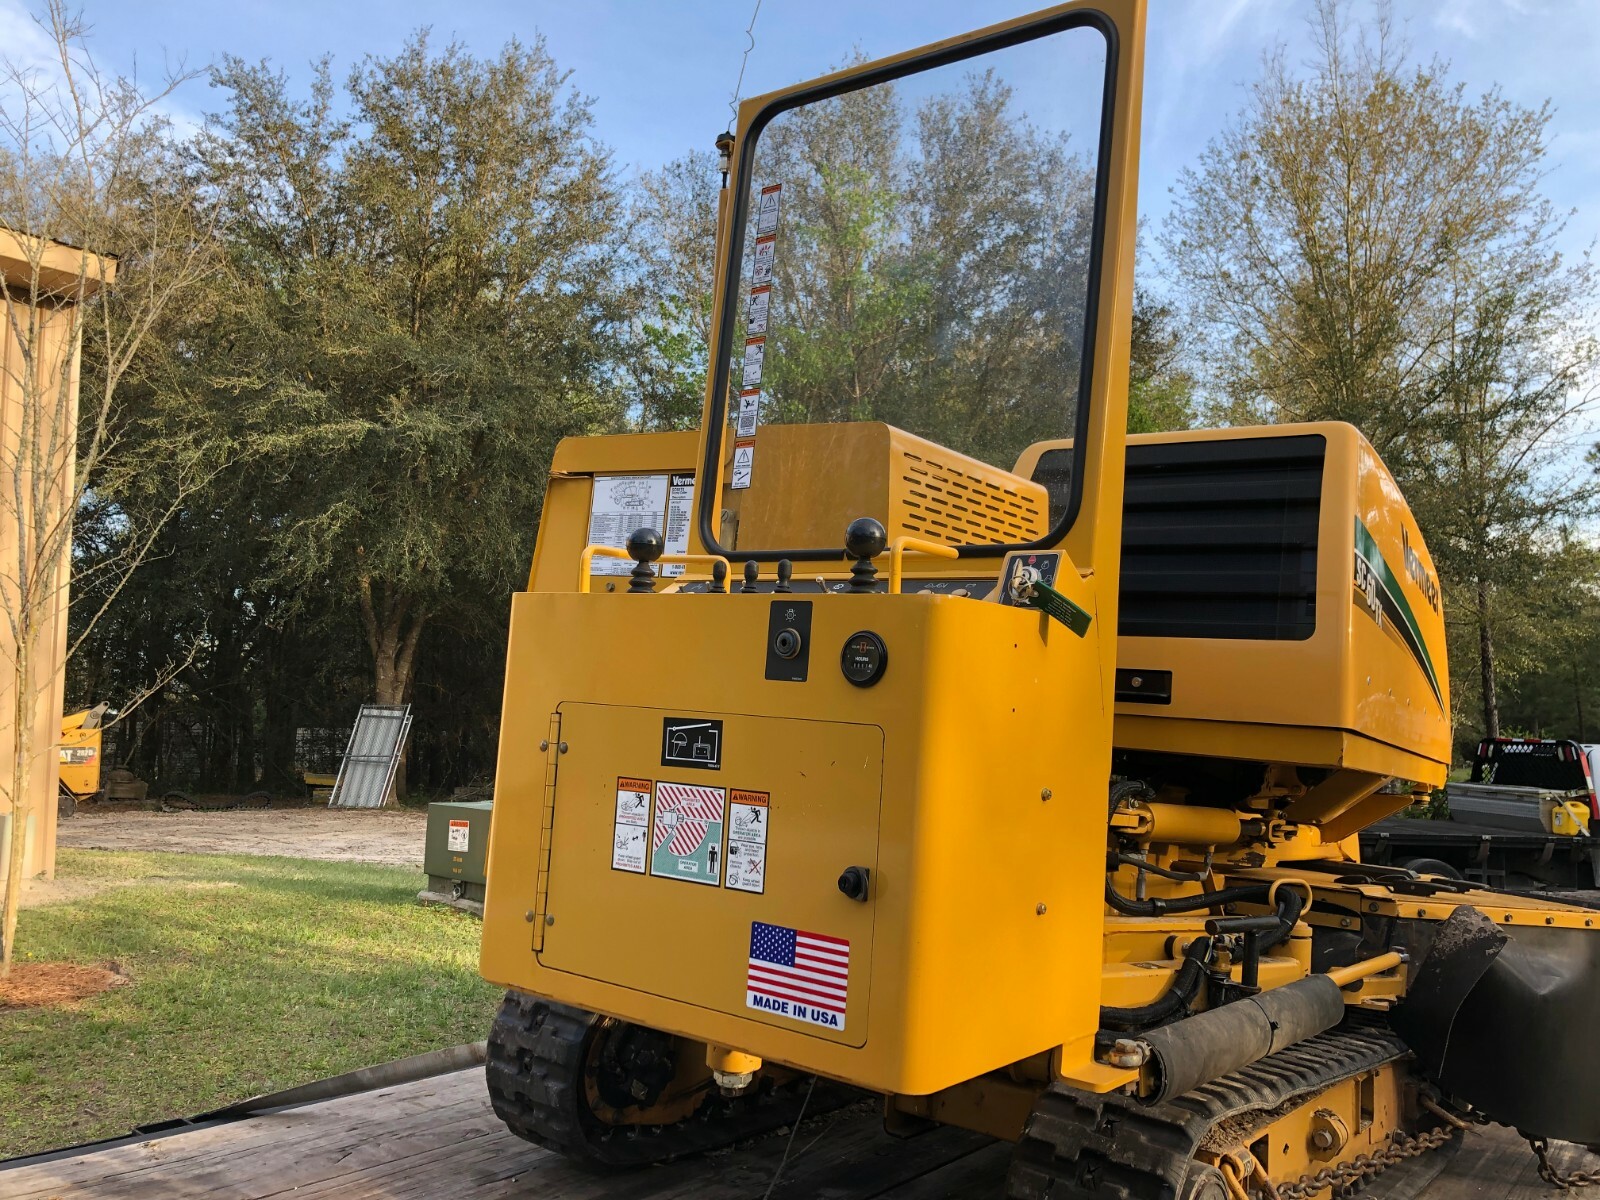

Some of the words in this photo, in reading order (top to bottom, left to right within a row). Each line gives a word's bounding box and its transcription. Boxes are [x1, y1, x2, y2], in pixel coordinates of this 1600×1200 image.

[738, 793, 767, 804] WARNING
[753, 994, 789, 1014] MADE
[793, 1004, 807, 1018] IN
[811, 1009, 838, 1026] USA
